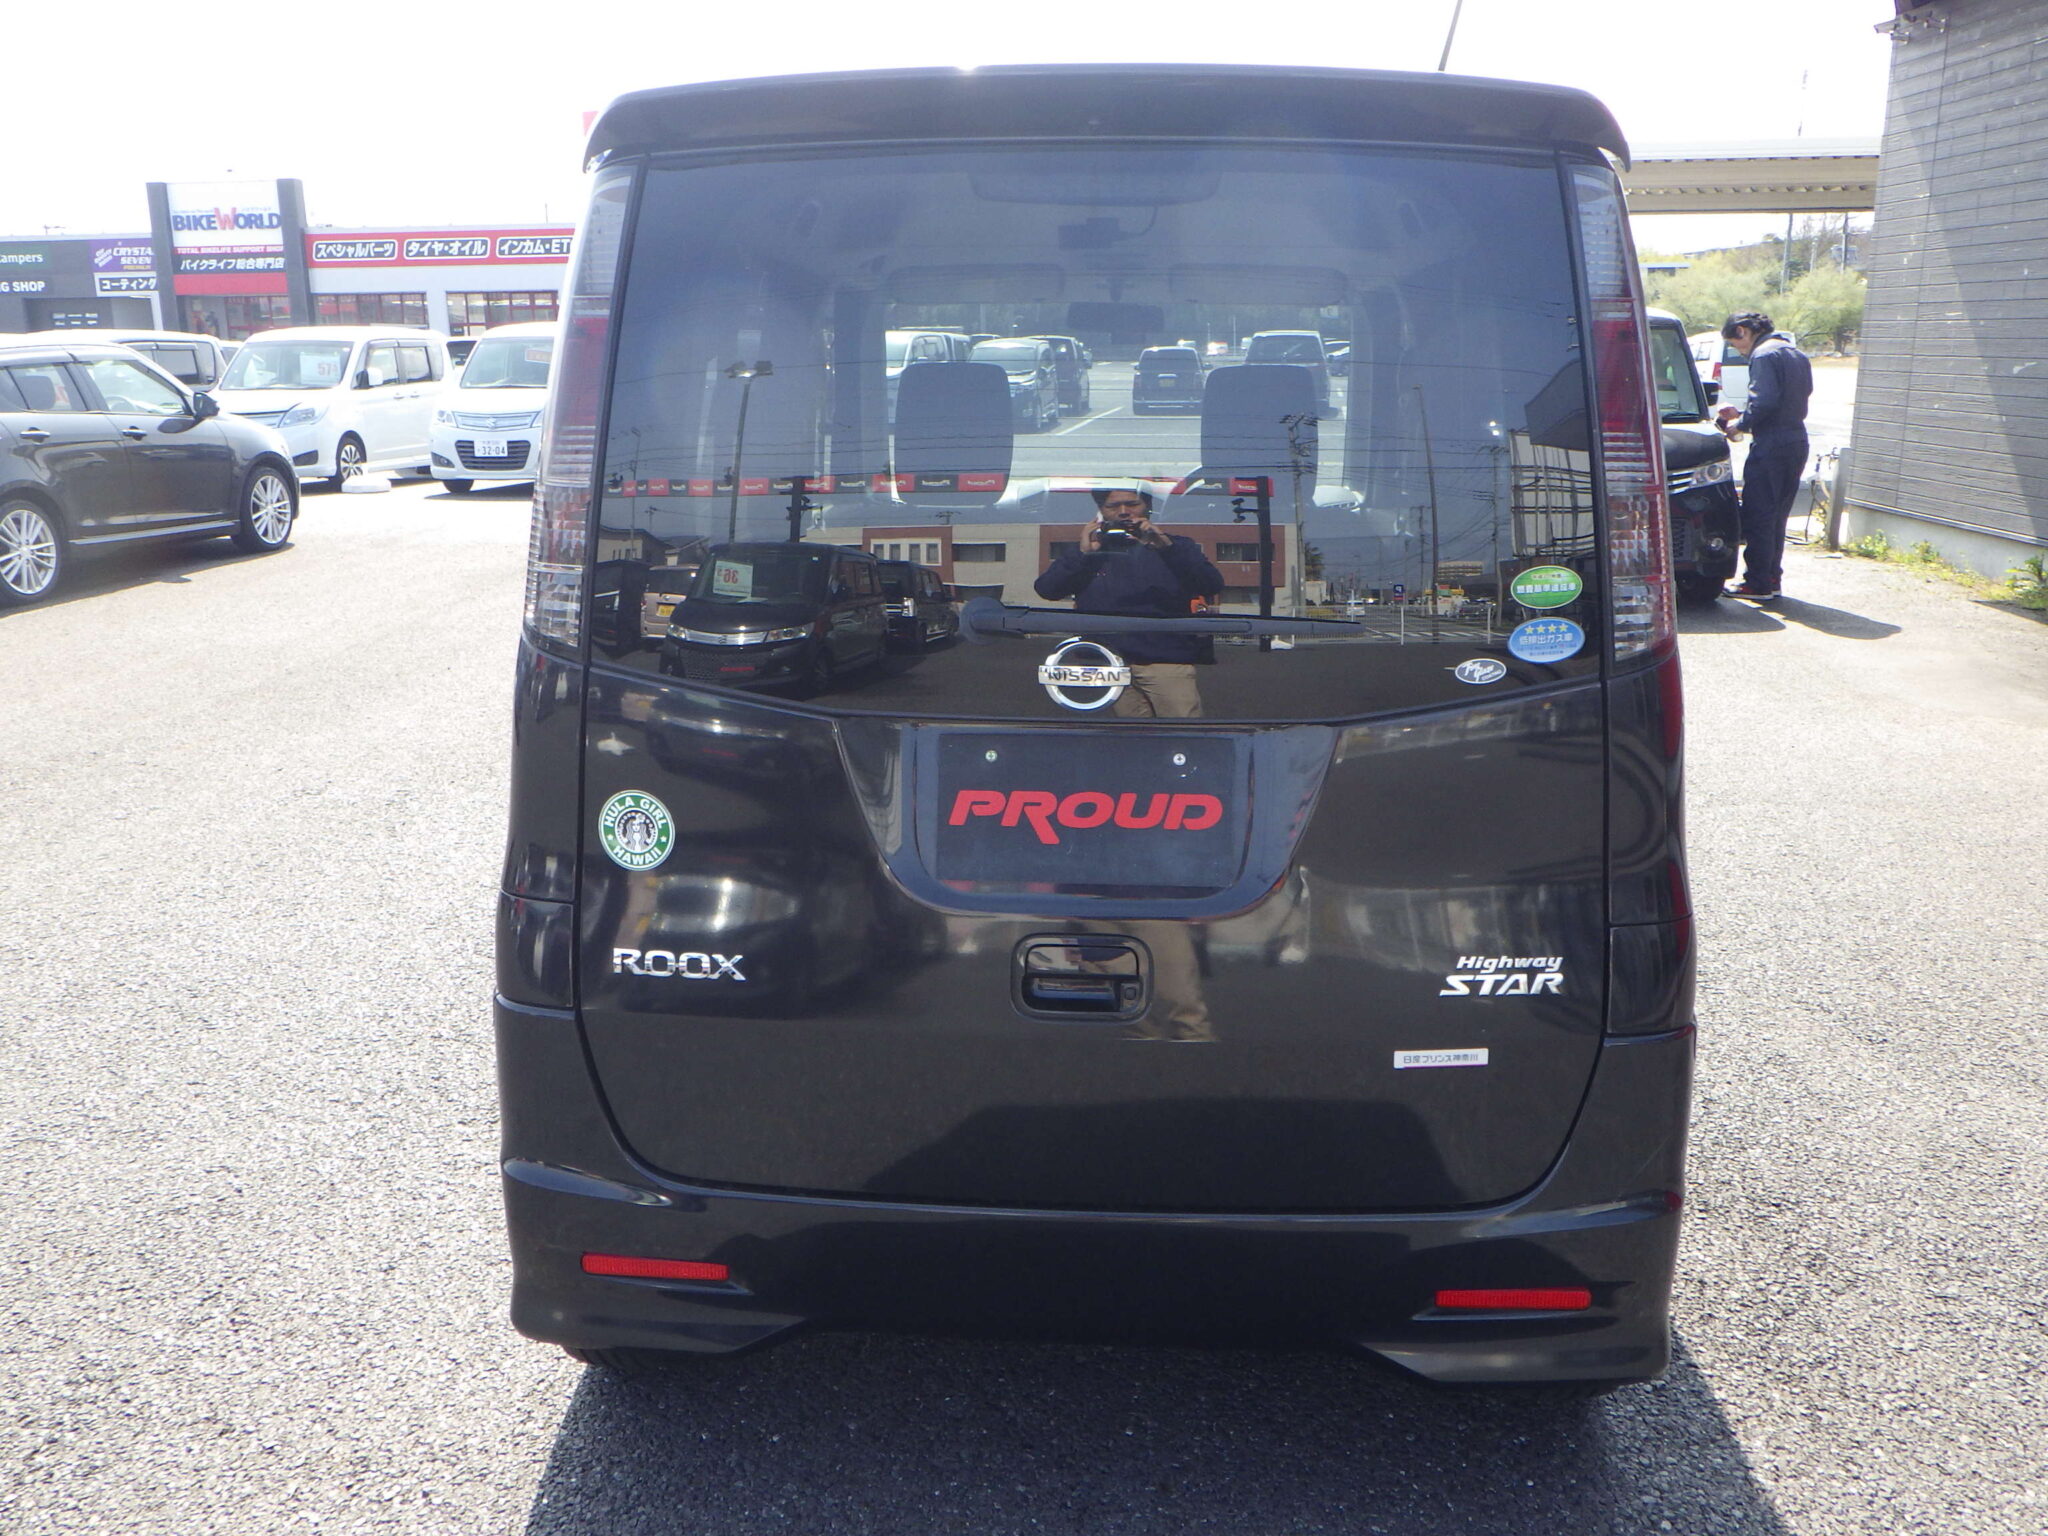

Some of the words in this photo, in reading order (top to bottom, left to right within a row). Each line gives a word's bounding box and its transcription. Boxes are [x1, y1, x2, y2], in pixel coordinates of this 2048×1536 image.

[172, 207, 282, 231] BIKEWORLD
[113, 247, 154, 256] CRYSTA
[316, 242, 394, 258] スペシャルパーツ
[500, 238, 571, 255] インカム・ET
[0, 254, 44, 265] ampers
[180, 257, 286, 271] バイクライフ総合専門店
[12, 280, 46, 292] SHOP
[102, 278, 157, 290] コーティング
[1048, 670, 1121, 682] NISSAN
[603, 796, 635, 828] HULA
[640, 798, 667, 829] GIRL
[948, 789, 1224, 845] PROUD
[613, 845, 662, 866] HAWAII
[613, 947, 746, 981] ROOX
[1456, 955, 1564, 974] Highway
[1439, 972, 1564, 996] STAR
